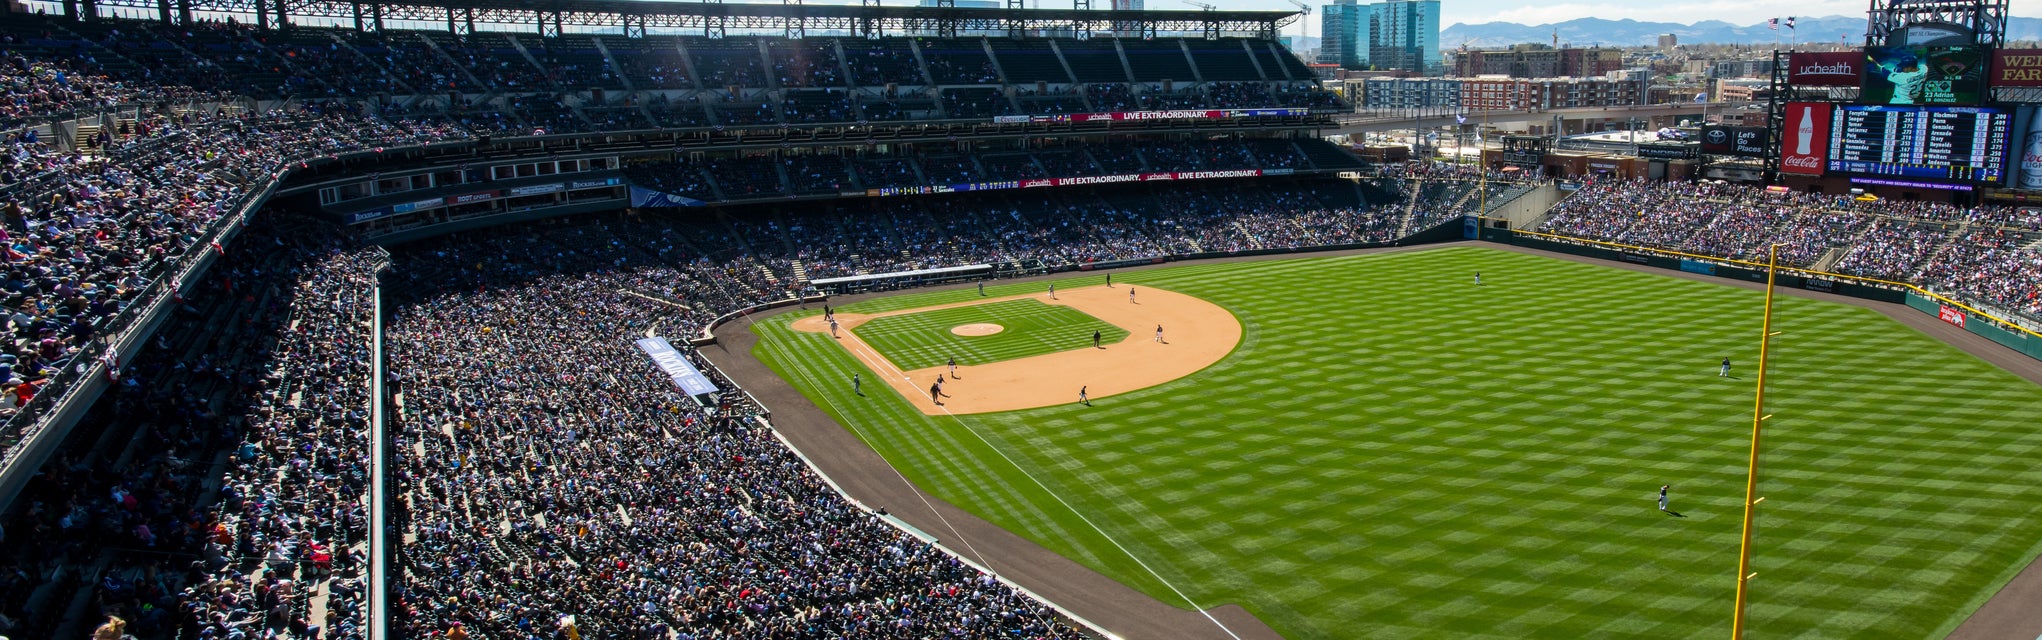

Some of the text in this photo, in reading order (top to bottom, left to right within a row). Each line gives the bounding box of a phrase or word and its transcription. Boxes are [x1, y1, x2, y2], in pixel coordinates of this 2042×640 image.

[1800, 62, 1851, 74] uchealth
[1142, 111, 1208, 120] EXTRAORDINARY.
[1077, 174, 1140, 184] EXTRAORDINARY.
[1195, 170, 1258, 179] EXTRAORDINARY.
[1026, 179, 1051, 187] uchealth
